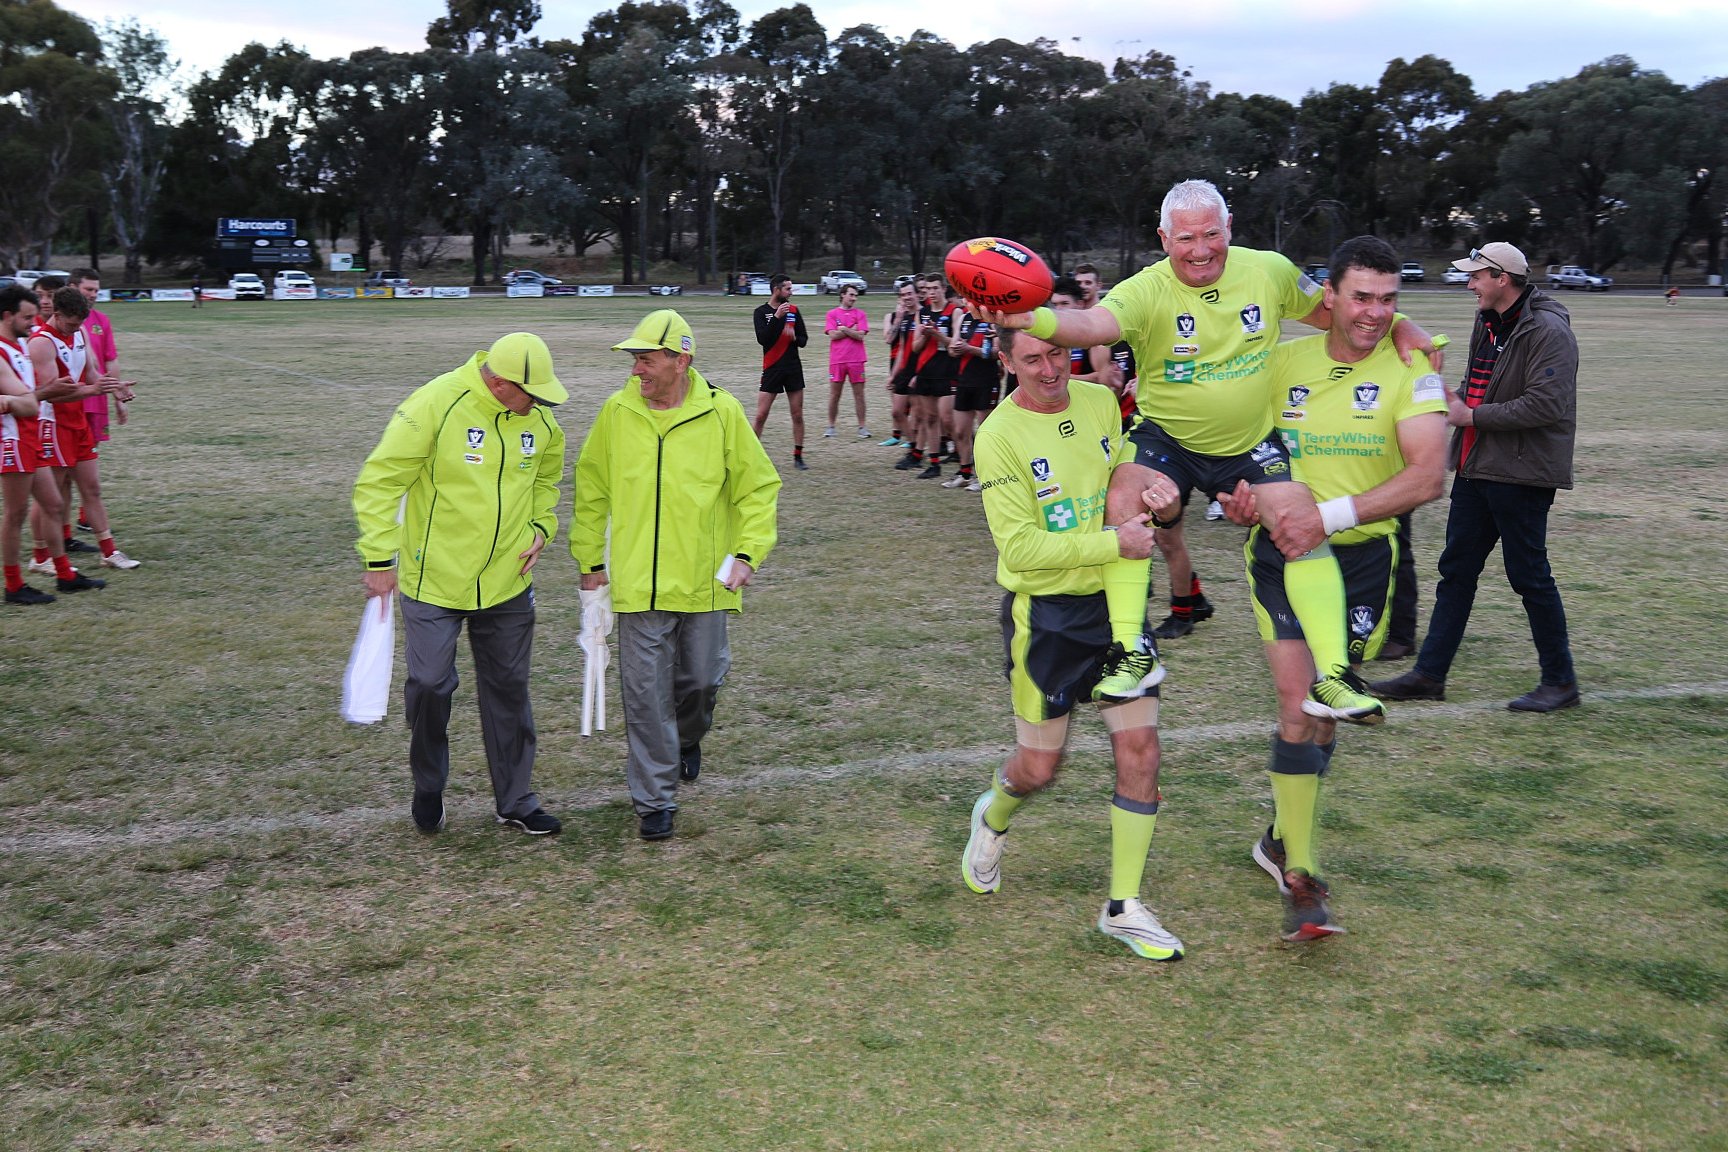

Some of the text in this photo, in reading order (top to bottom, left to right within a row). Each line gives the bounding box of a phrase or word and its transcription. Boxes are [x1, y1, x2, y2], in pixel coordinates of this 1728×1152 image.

[228, 219, 287, 231] Harcourts
[1302, 432, 1386, 446] TerryWhite
[980, 474, 1019, 491] eaworks
